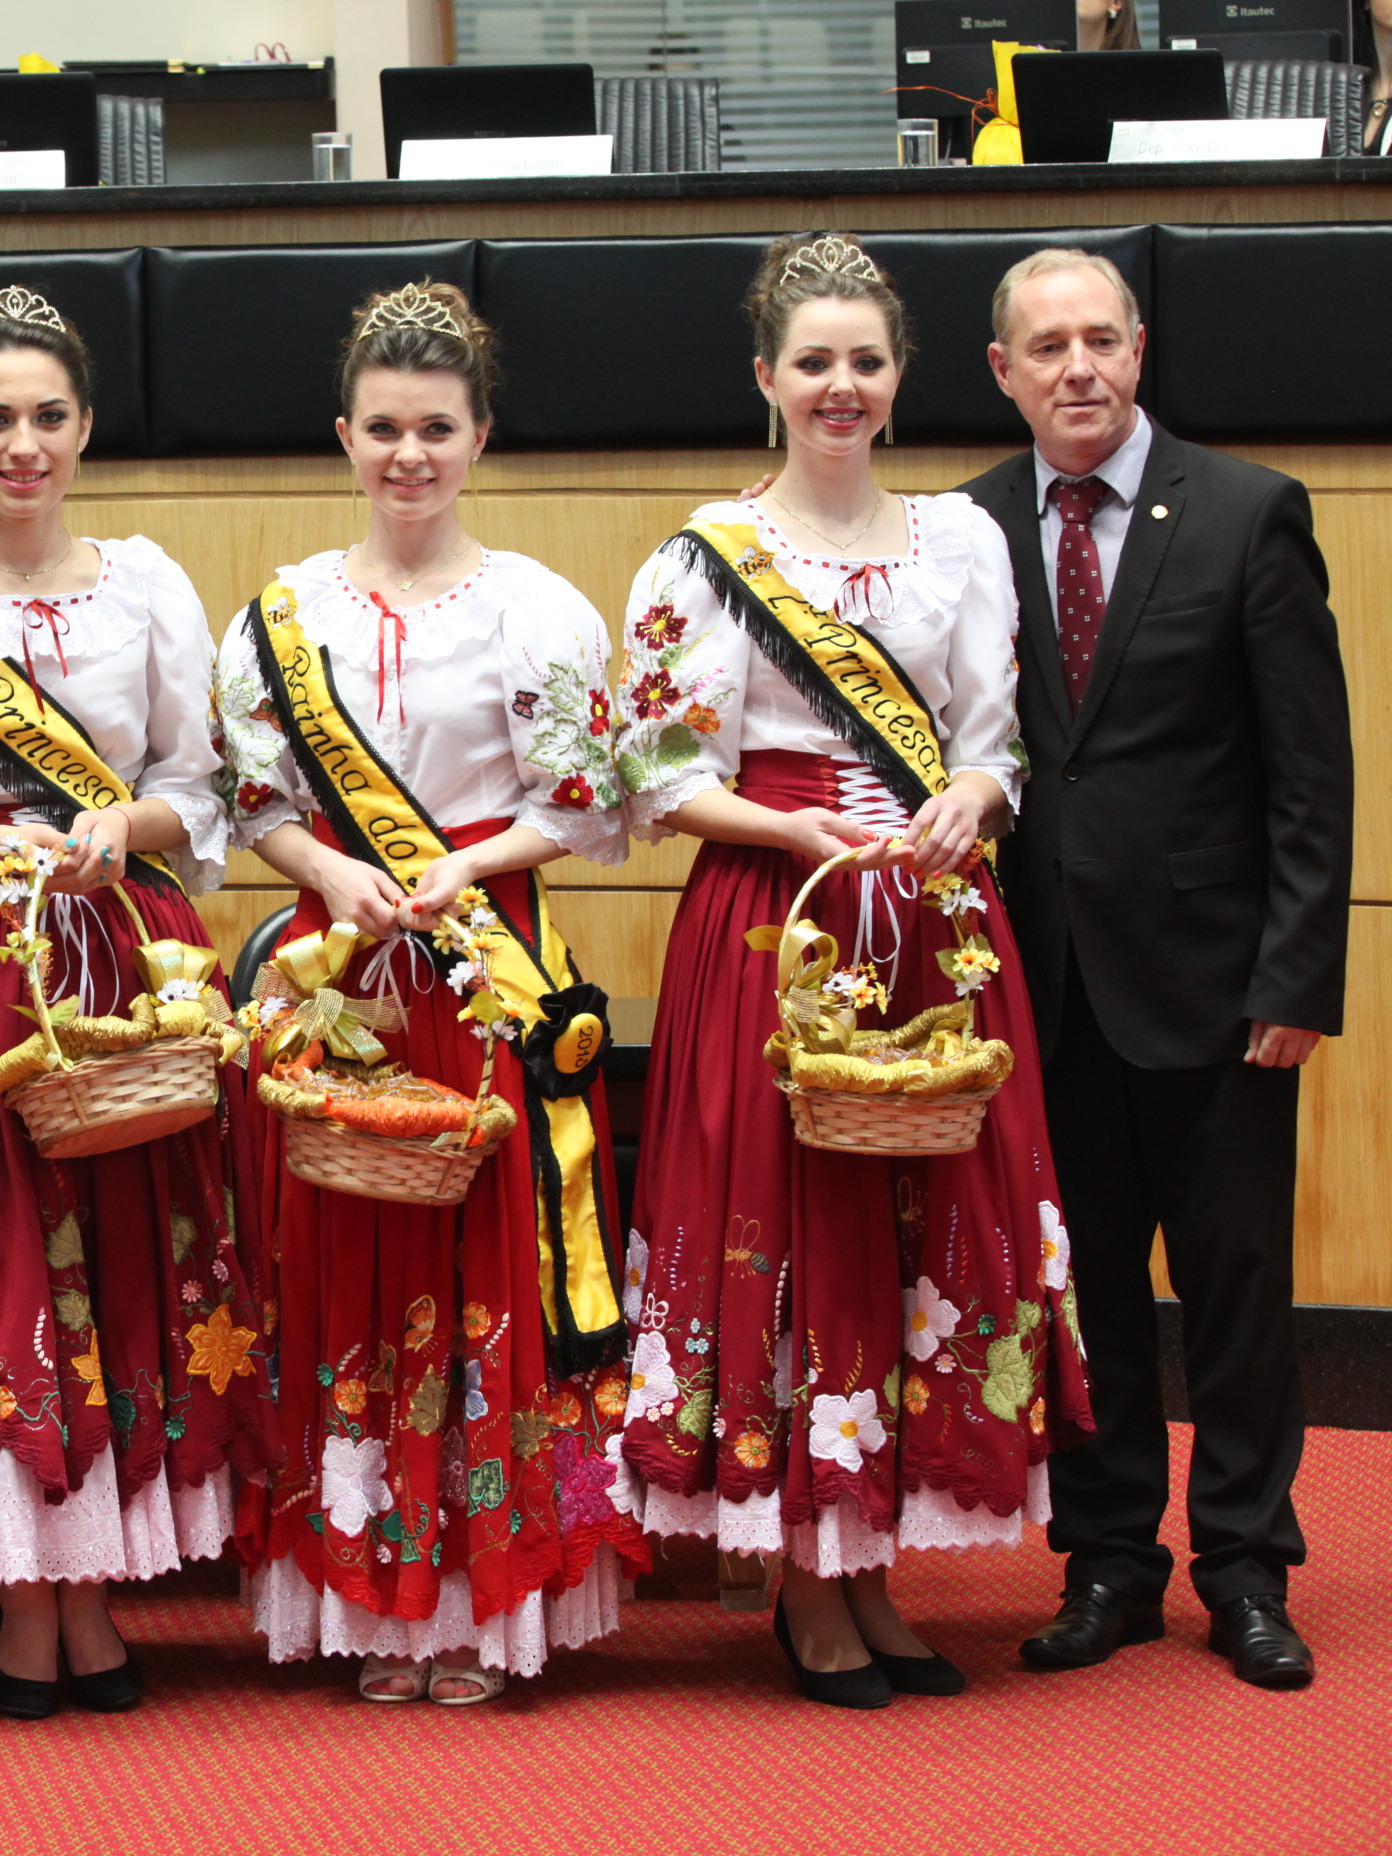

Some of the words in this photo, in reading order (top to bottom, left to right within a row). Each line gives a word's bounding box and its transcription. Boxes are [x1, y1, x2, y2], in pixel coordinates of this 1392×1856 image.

[281, 645, 373, 796] Rainha
[368, 815, 419, 861] do
[802, 622, 938, 774] Princesa
